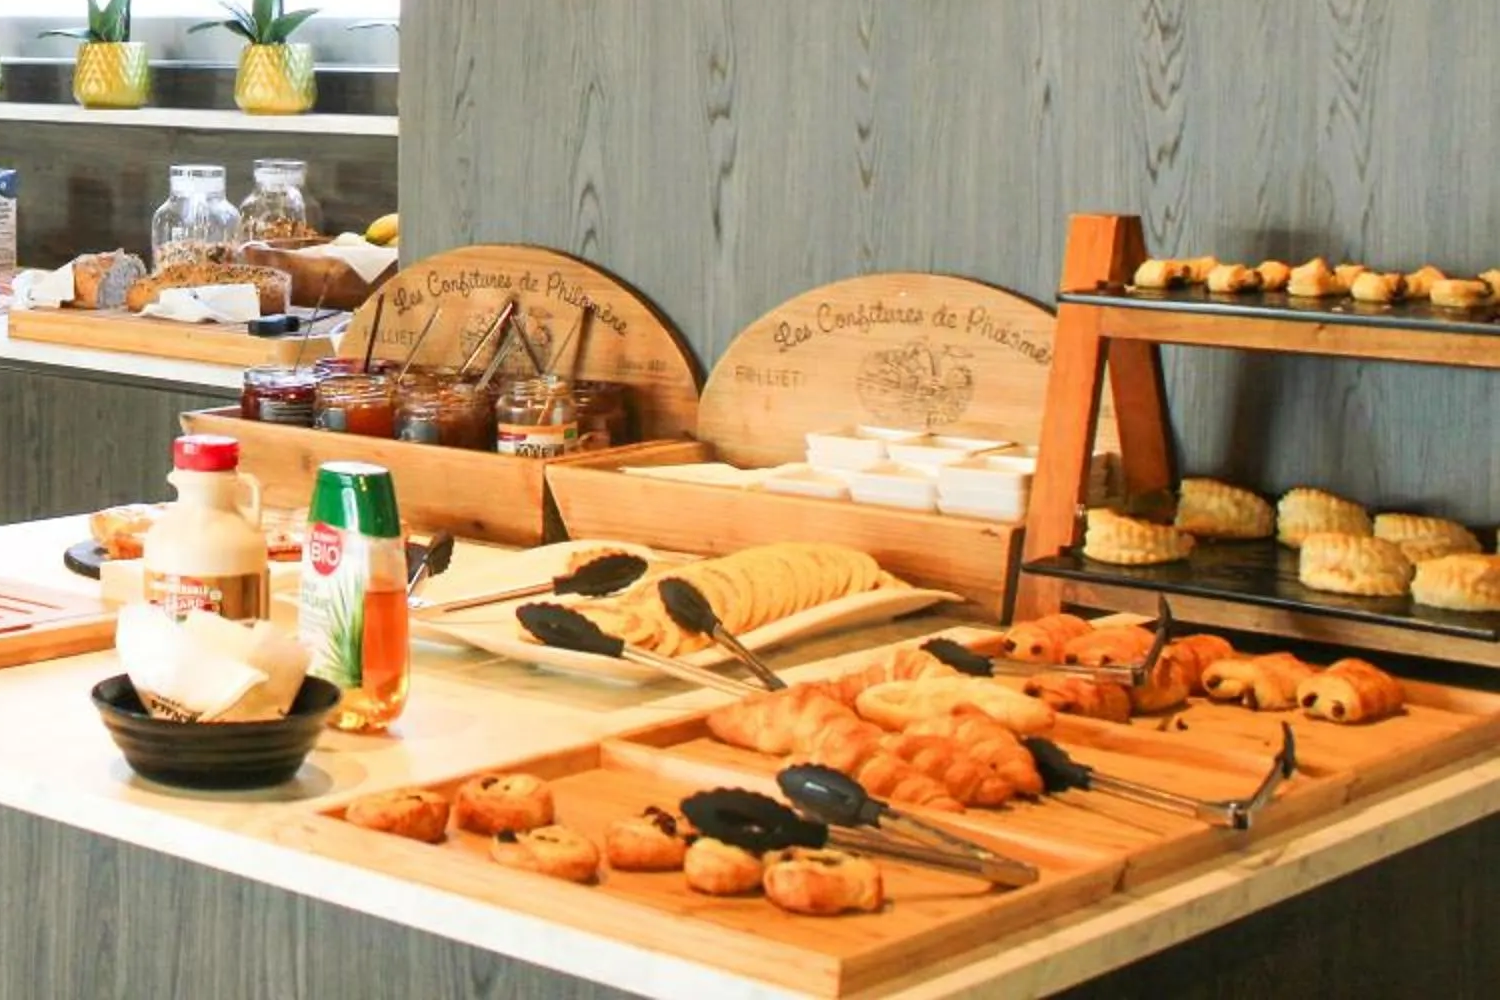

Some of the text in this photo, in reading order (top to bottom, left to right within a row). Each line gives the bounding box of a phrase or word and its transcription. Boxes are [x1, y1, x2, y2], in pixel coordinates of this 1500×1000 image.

[426, 271, 513, 299] Confitures
[518, 272, 539, 293] de
[774, 321, 813, 353] Les
[816, 300, 925, 334] Confitures
[932, 302, 958, 329] de
[311, 541, 341, 566] BIO
